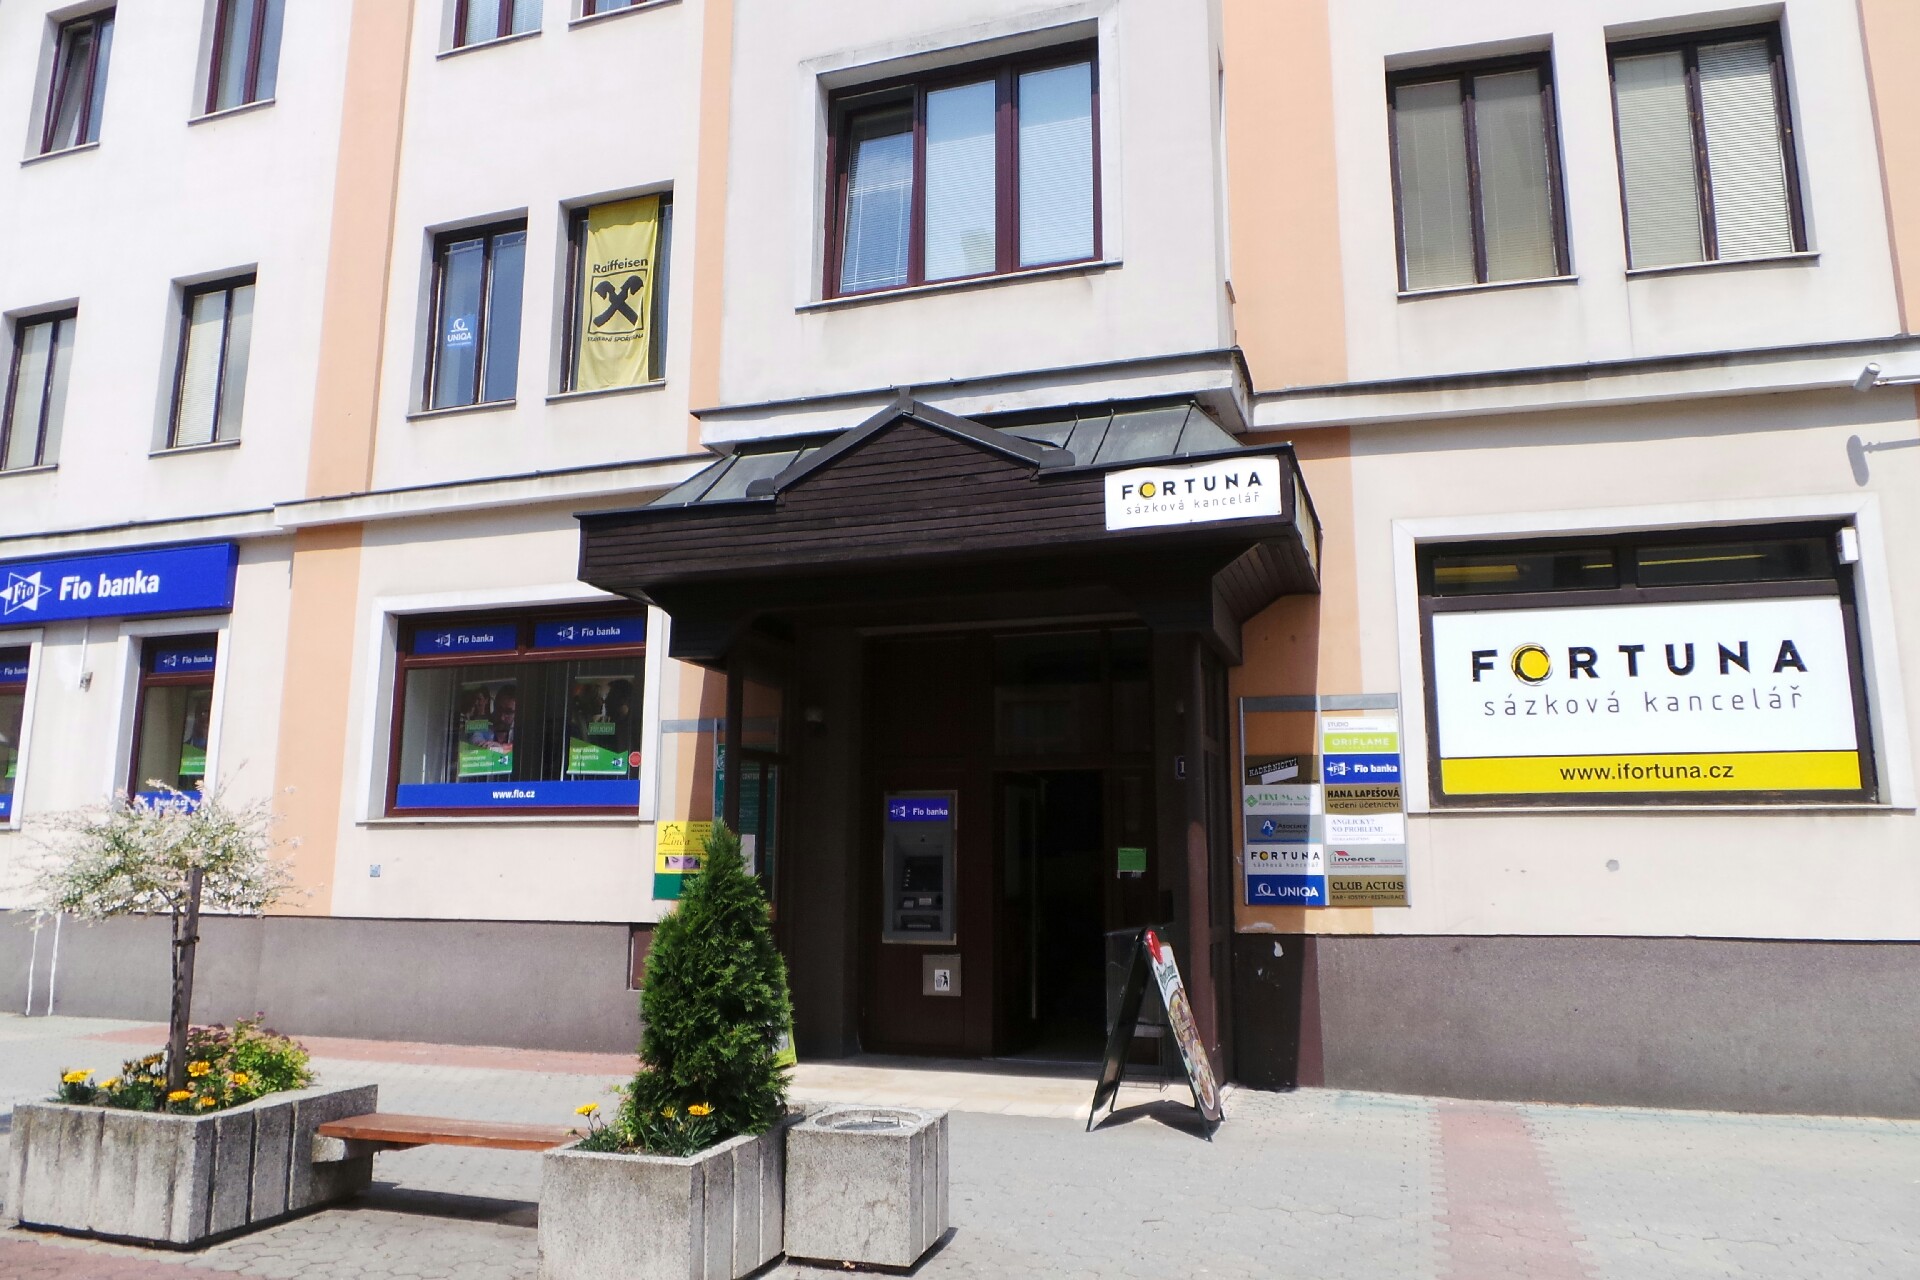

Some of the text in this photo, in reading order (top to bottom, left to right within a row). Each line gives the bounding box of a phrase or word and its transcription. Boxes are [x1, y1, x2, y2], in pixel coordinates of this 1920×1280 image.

[593, 257, 648, 273] Raiffeisen
[447, 332, 472, 342] UNIQA
[1122, 471, 1262, 500] FORTUNA
[1126, 492, 1260, 515] sázková kancelář
[59, 570, 160, 600] Fio banka
[581, 626, 621, 637] Fio banka
[457, 634, 494, 644] Fio banka
[182, 656, 192, 664] Fio
[1471, 640, 1808, 686] FORTUNA
[1484, 685, 1803, 716] sázková kancelář
[1332, 738, 1390, 746] ORIFLAME
[1354, 763, 1398, 773] Fio banka
[1560, 763, 1734, 781] www.ifortuna.cz
[492, 790, 535, 799] www.fio.cz
[1327, 787, 1400, 798] HANA LAPEŠOVÁ
[912, 807, 925, 816] Fio
[926, 807, 948, 816] banka
[1251, 851, 1320, 861] FORTUNA
[1278, 886, 1319, 897] UNIQA
[1332, 881, 1404, 891] CLUB ACTUS
